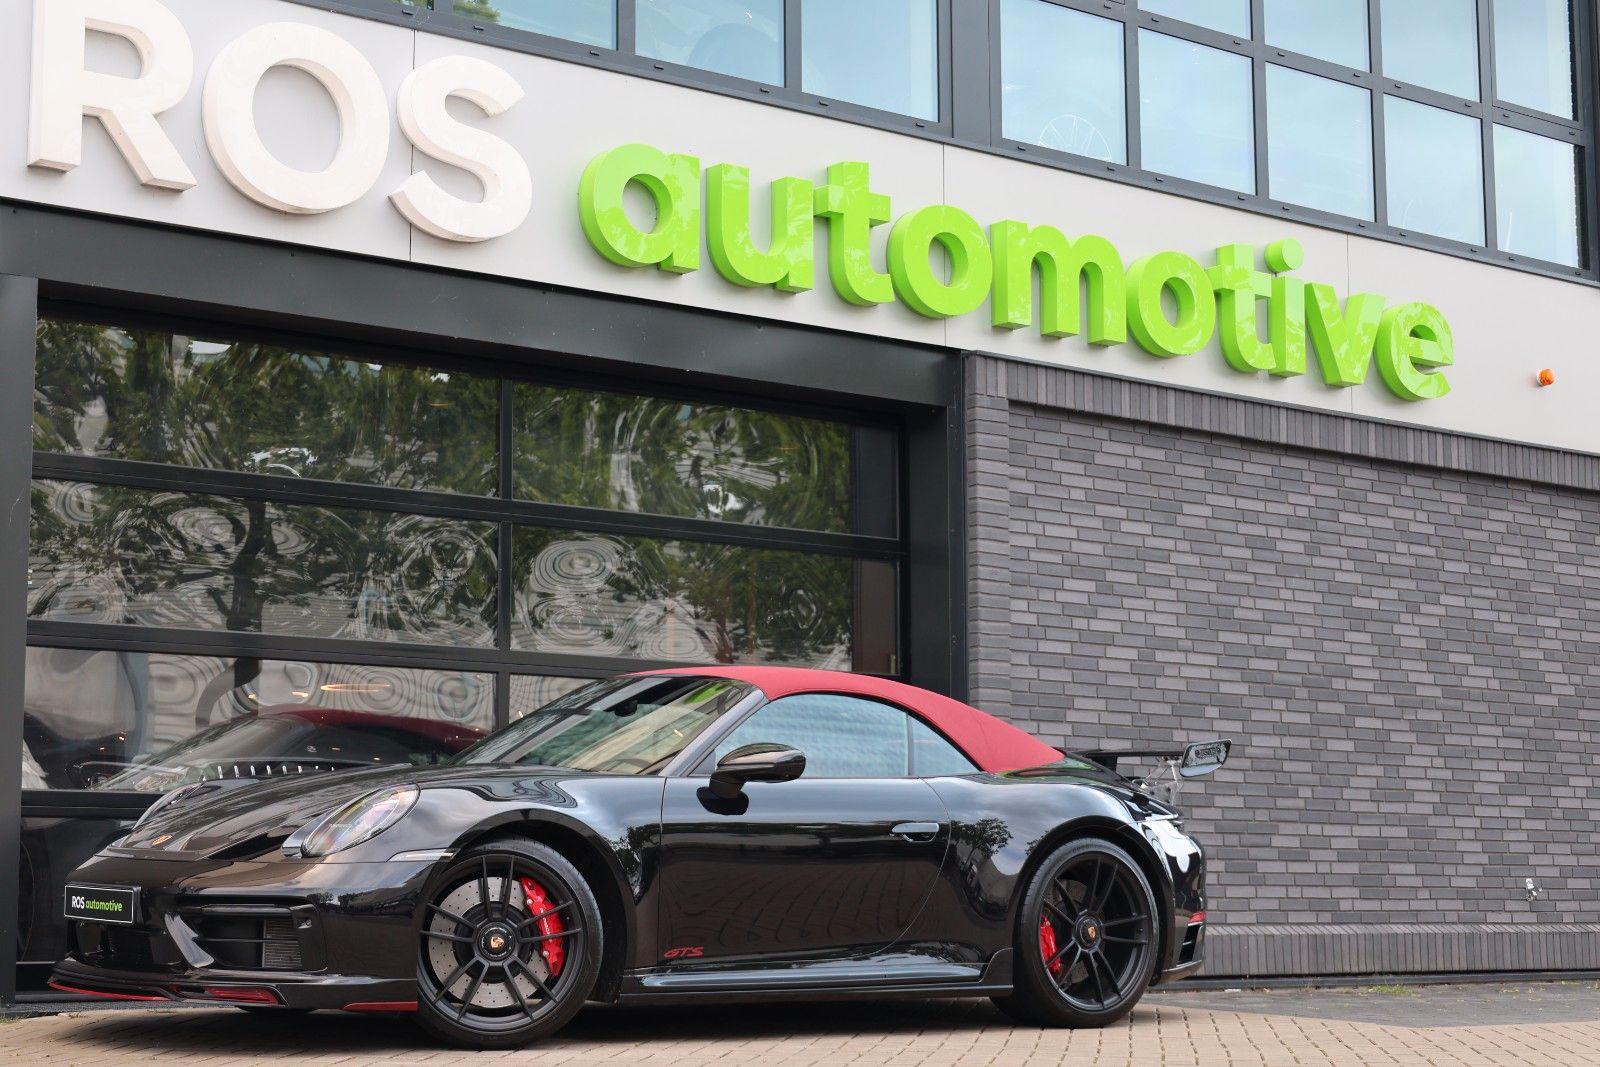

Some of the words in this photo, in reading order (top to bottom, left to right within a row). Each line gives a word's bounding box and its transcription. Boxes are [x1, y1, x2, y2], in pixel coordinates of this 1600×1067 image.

[28, 0, 532, 242] ROS
[579, 143, 1454, 401] automotive
[71, 895, 85, 909] ROS
[85, 899, 123, 912] automotive
[663, 946, 705, 958] GTS
